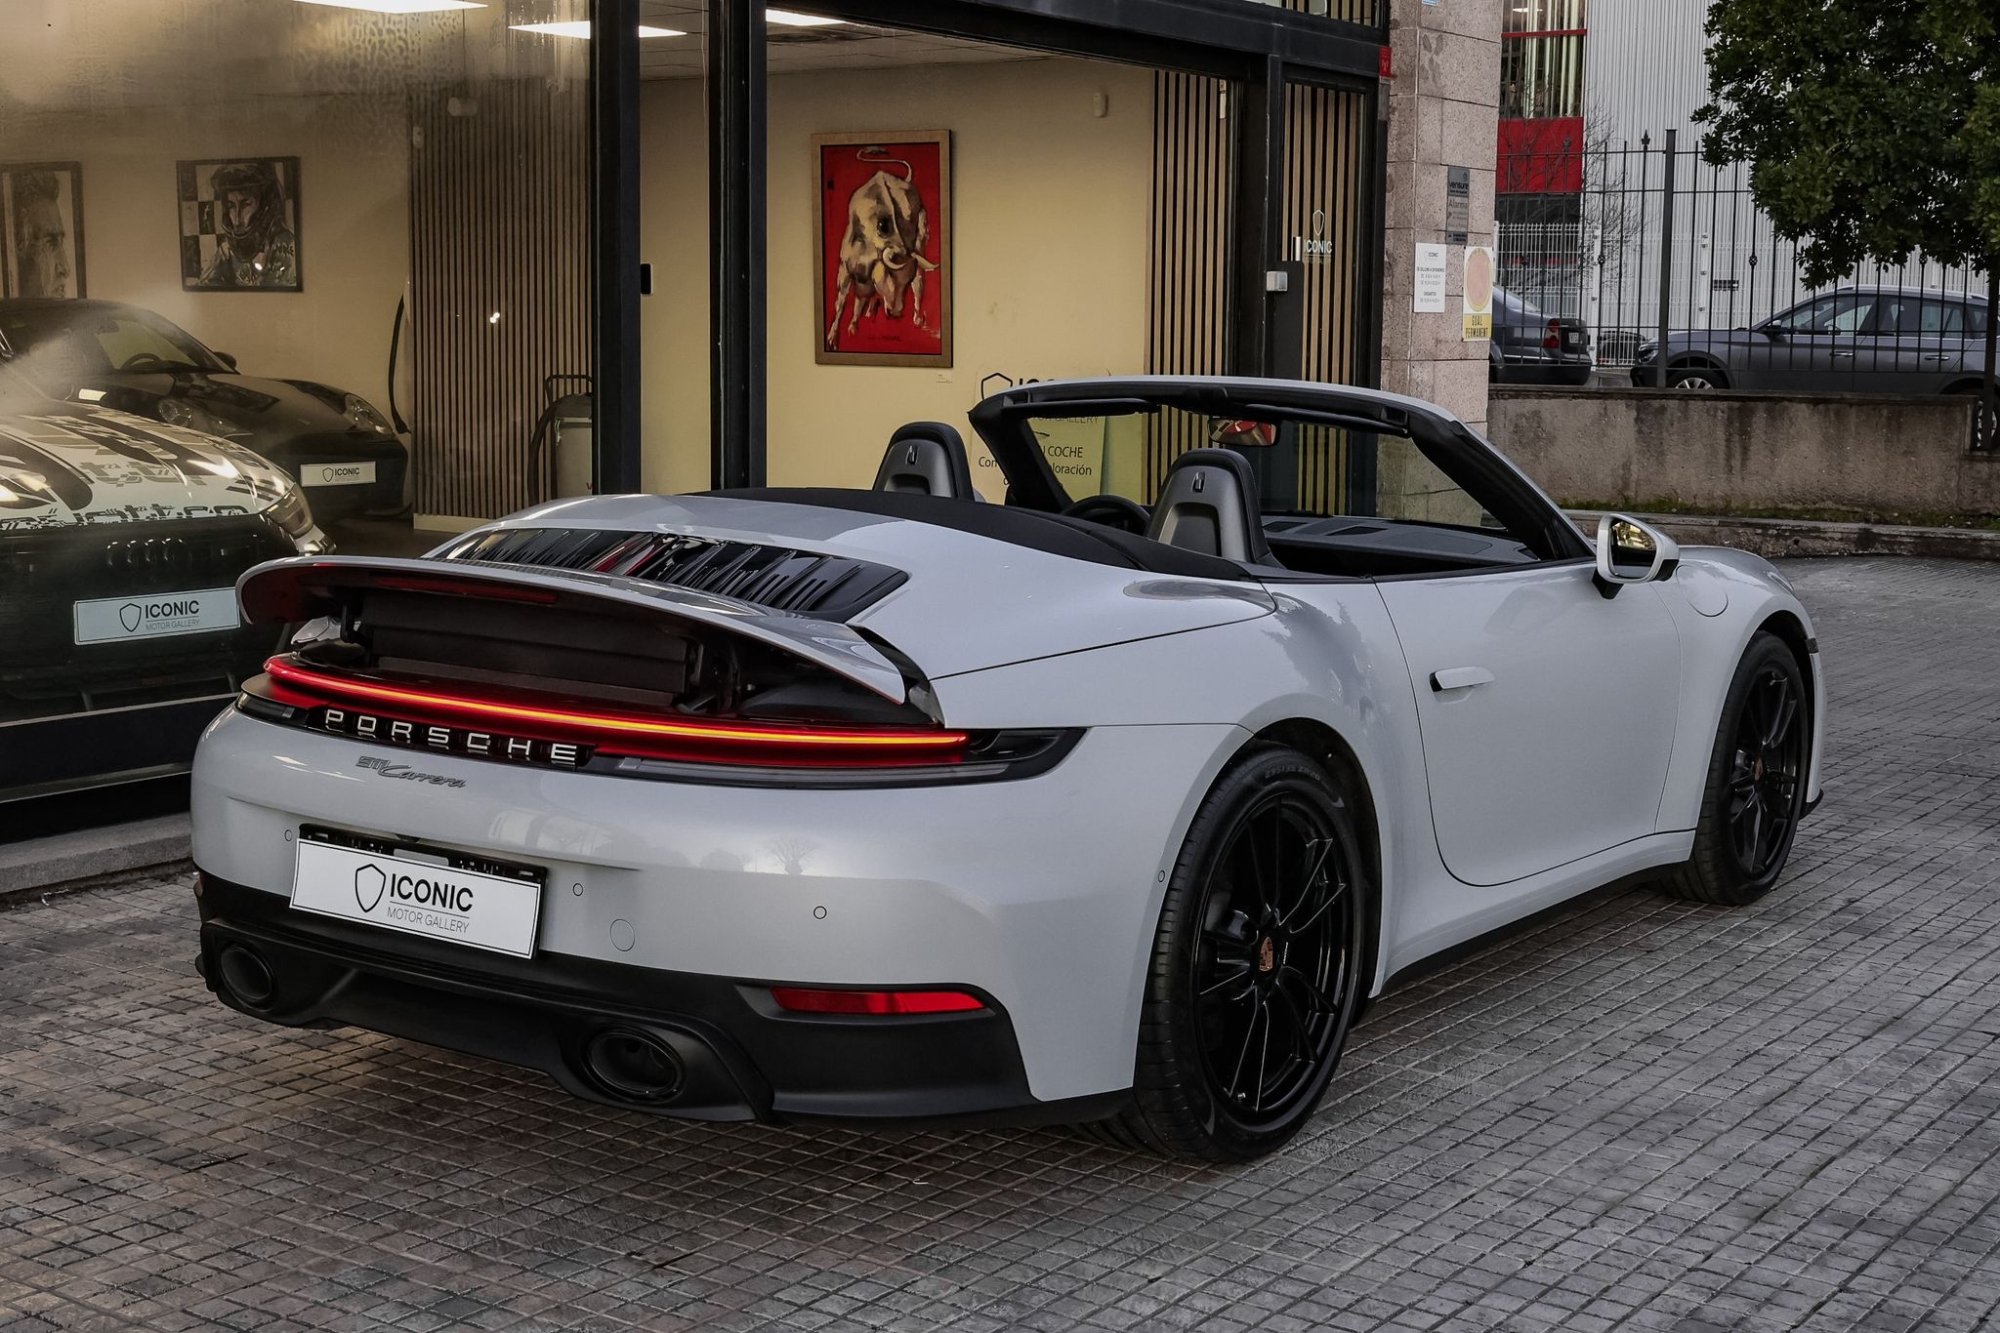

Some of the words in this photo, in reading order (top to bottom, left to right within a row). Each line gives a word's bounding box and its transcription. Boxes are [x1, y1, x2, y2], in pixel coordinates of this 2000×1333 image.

[1465, 327, 1489, 339] PERMANENT
[1047, 445, 1084, 458] COCHE
[334, 467, 360, 476] ICONIC
[1052, 462, 1092, 476] loración
[145, 600, 200, 619] ICONIC
[145, 622, 170, 631] MOTOR
[171, 619, 200, 629] GALLERY
[325, 709, 577, 761] PORSCHE
[356, 755, 391, 770] 911
[377, 764, 466, 788] Carrera
[390, 873, 474, 912] ICONIC
[387, 906, 423, 925] MOTOR
[424, 914, 470, 933] GALLERY
